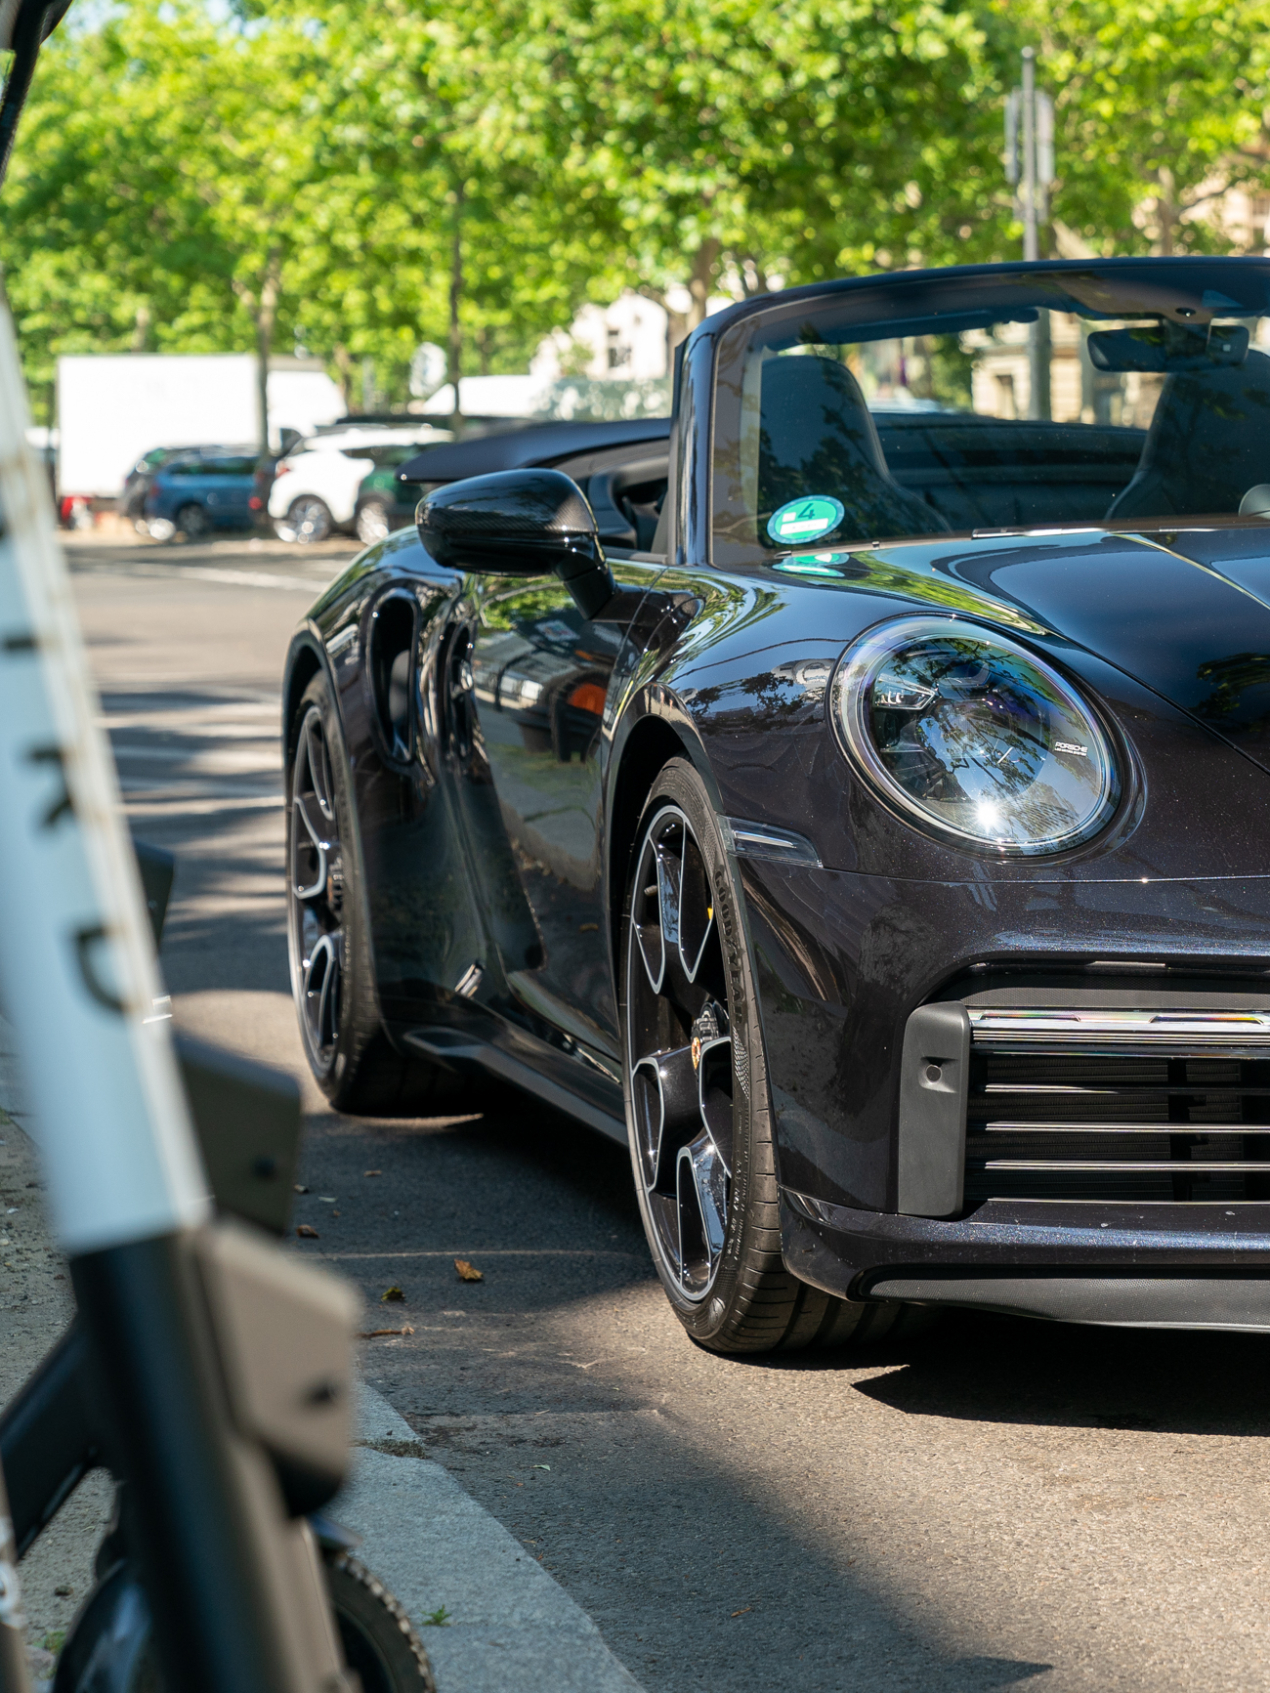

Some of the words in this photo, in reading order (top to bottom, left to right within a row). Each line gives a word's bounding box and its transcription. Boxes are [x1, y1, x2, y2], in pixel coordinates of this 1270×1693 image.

[798, 502, 816, 520] 4
[1055, 741, 1088, 752] PORSCHE
[714, 870, 743, 1024] GOODYEAR
